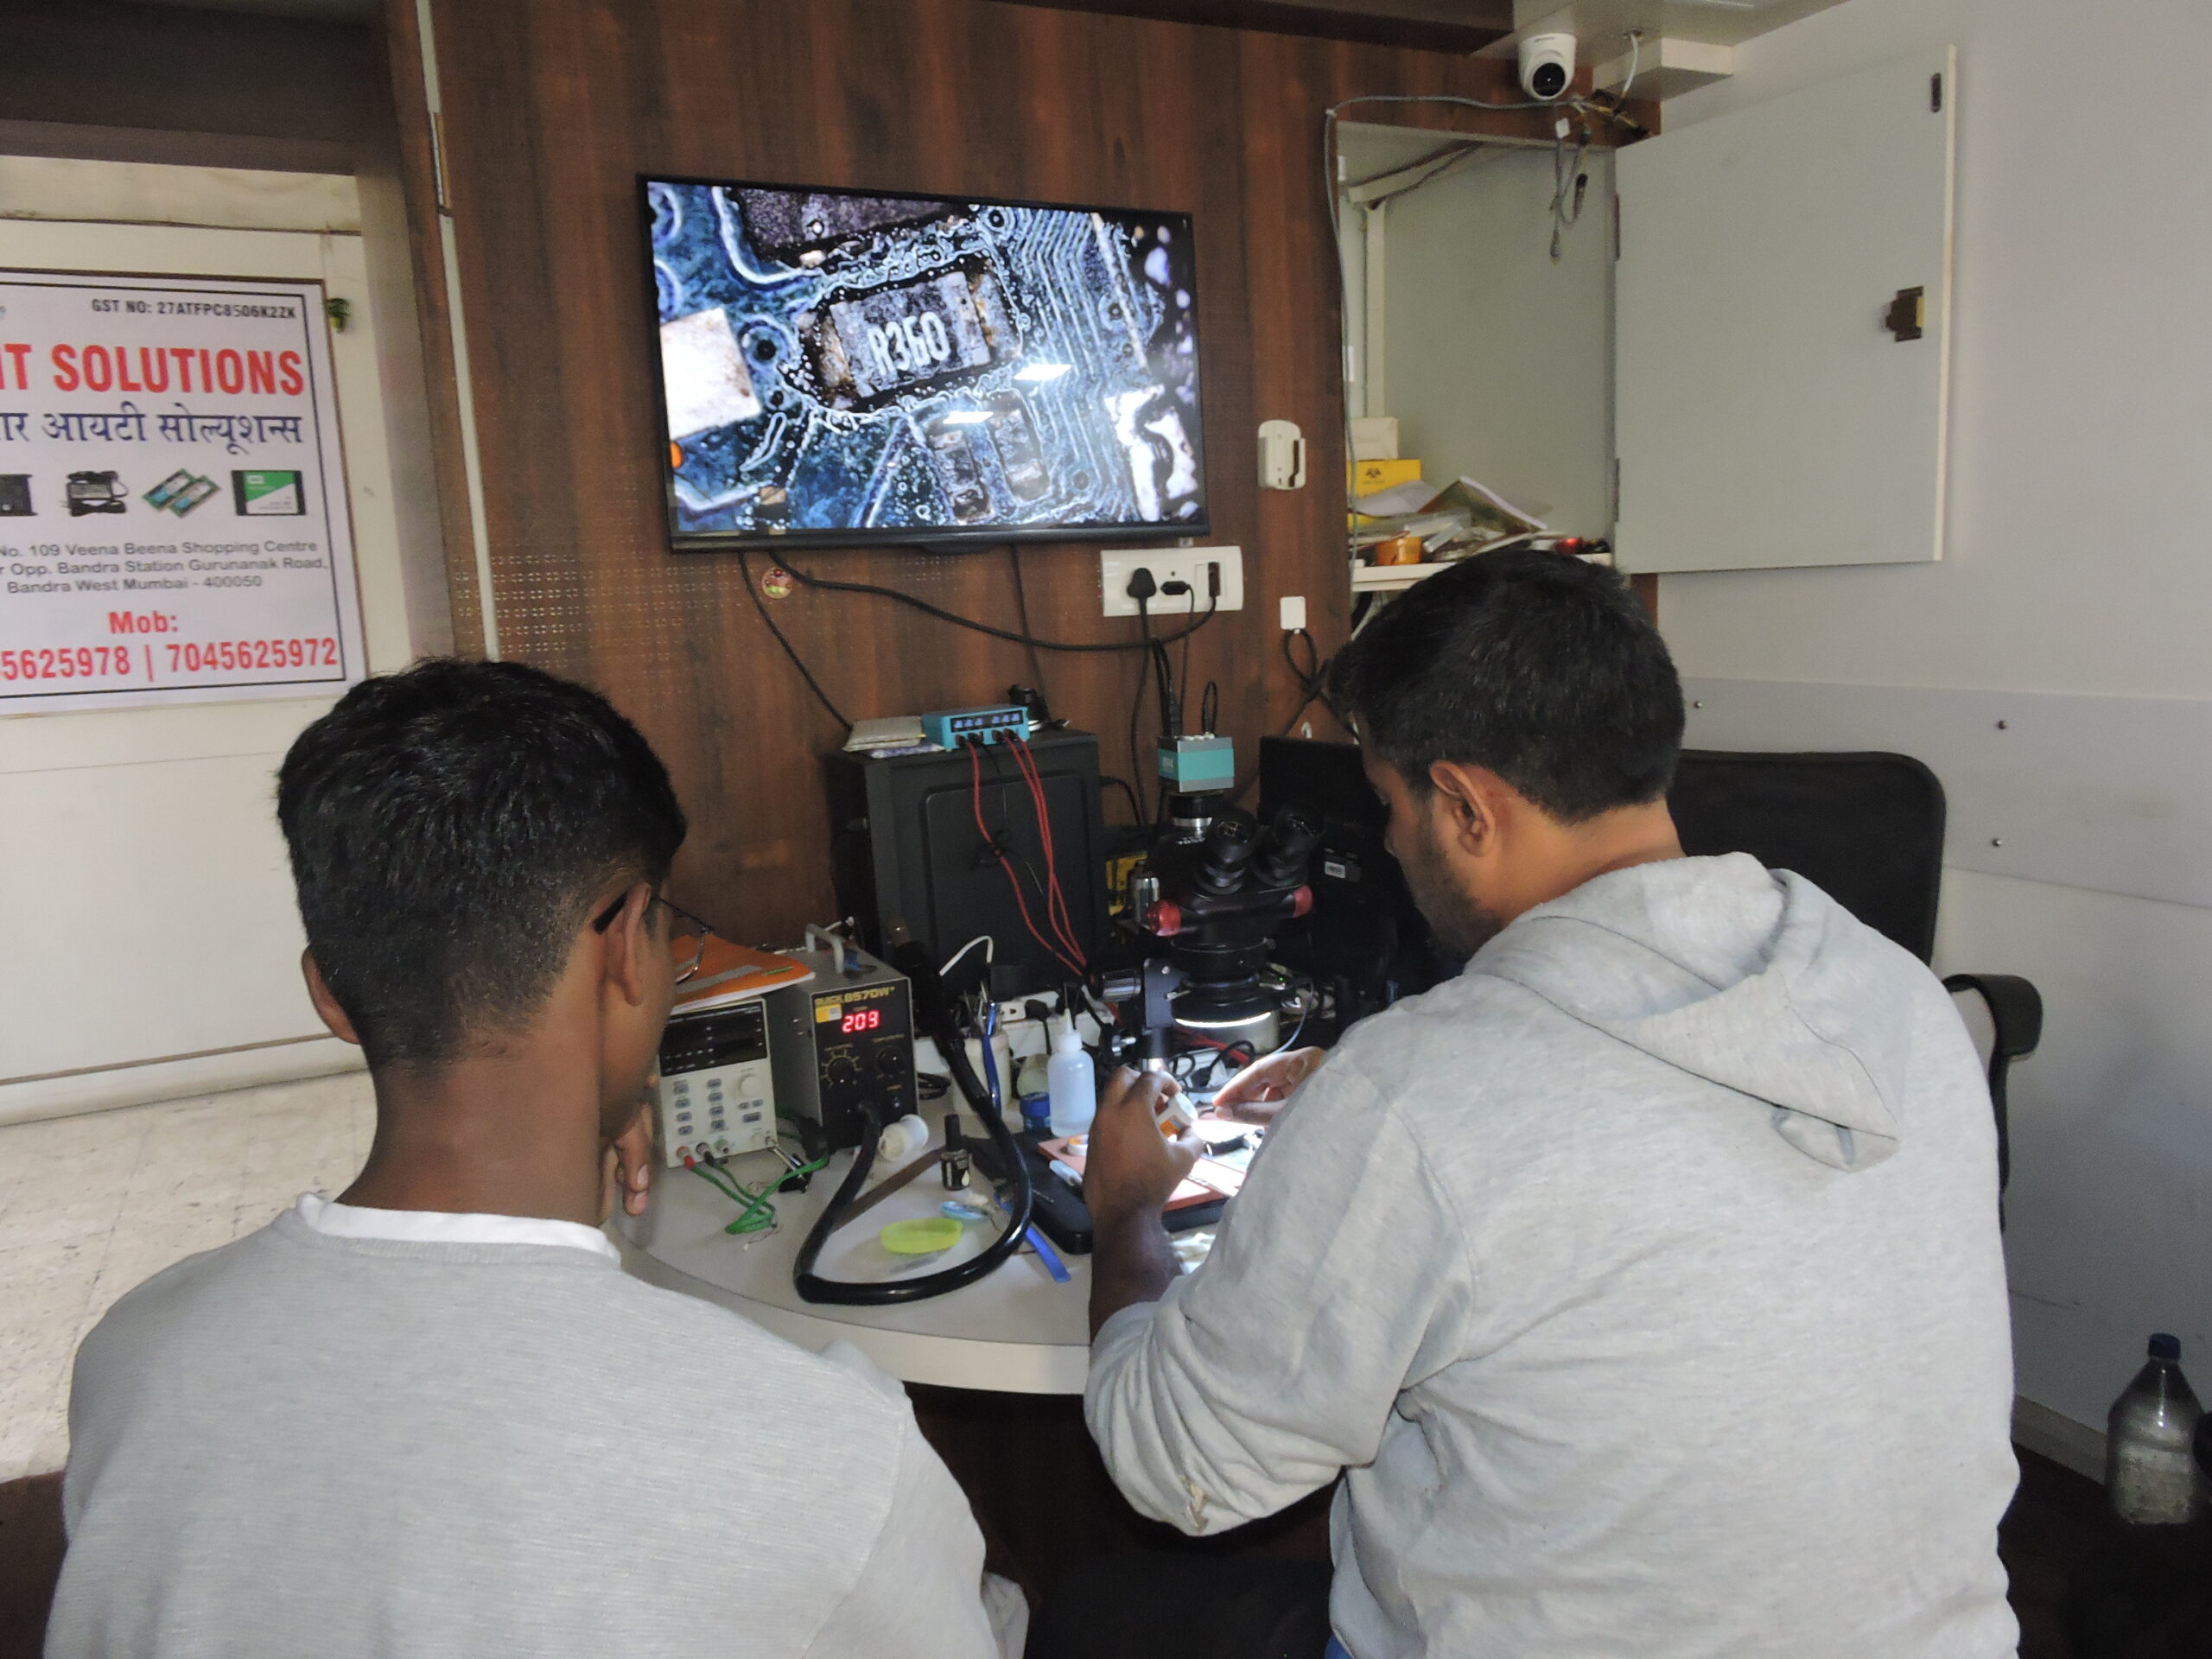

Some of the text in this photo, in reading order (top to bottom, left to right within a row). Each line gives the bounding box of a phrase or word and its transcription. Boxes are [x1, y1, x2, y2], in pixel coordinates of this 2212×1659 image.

[91, 298, 119, 314] GST
[125, 300, 153, 315] NO:
[0, 343, 304, 397] T SOLUTIONS
[41, 400, 147, 442] आयटी
[156, 402, 303, 455] सोल्यूशन्स
[29, 544, 60, 556] 109
[65, 543, 118, 556] Veena
[124, 543, 177, 555] Beena
[182, 541, 259, 555] Shopping
[264, 540, 317, 552] Centre
[10, 563, 51, 578] Opp.
[58, 562, 119, 574] Bandra
[125, 560, 183, 572] Station
[188, 559, 277, 571] Gurunanak
[8, 581, 71, 594] Bandra
[75, 579, 118, 591] West
[124, 577, 188, 590] Mumbai
[203, 575, 262, 588] 400050
[108, 611, 178, 634] Mob:
[167, 637, 337, 672] 7045625972
[842, 1009, 880, 1033] 209
